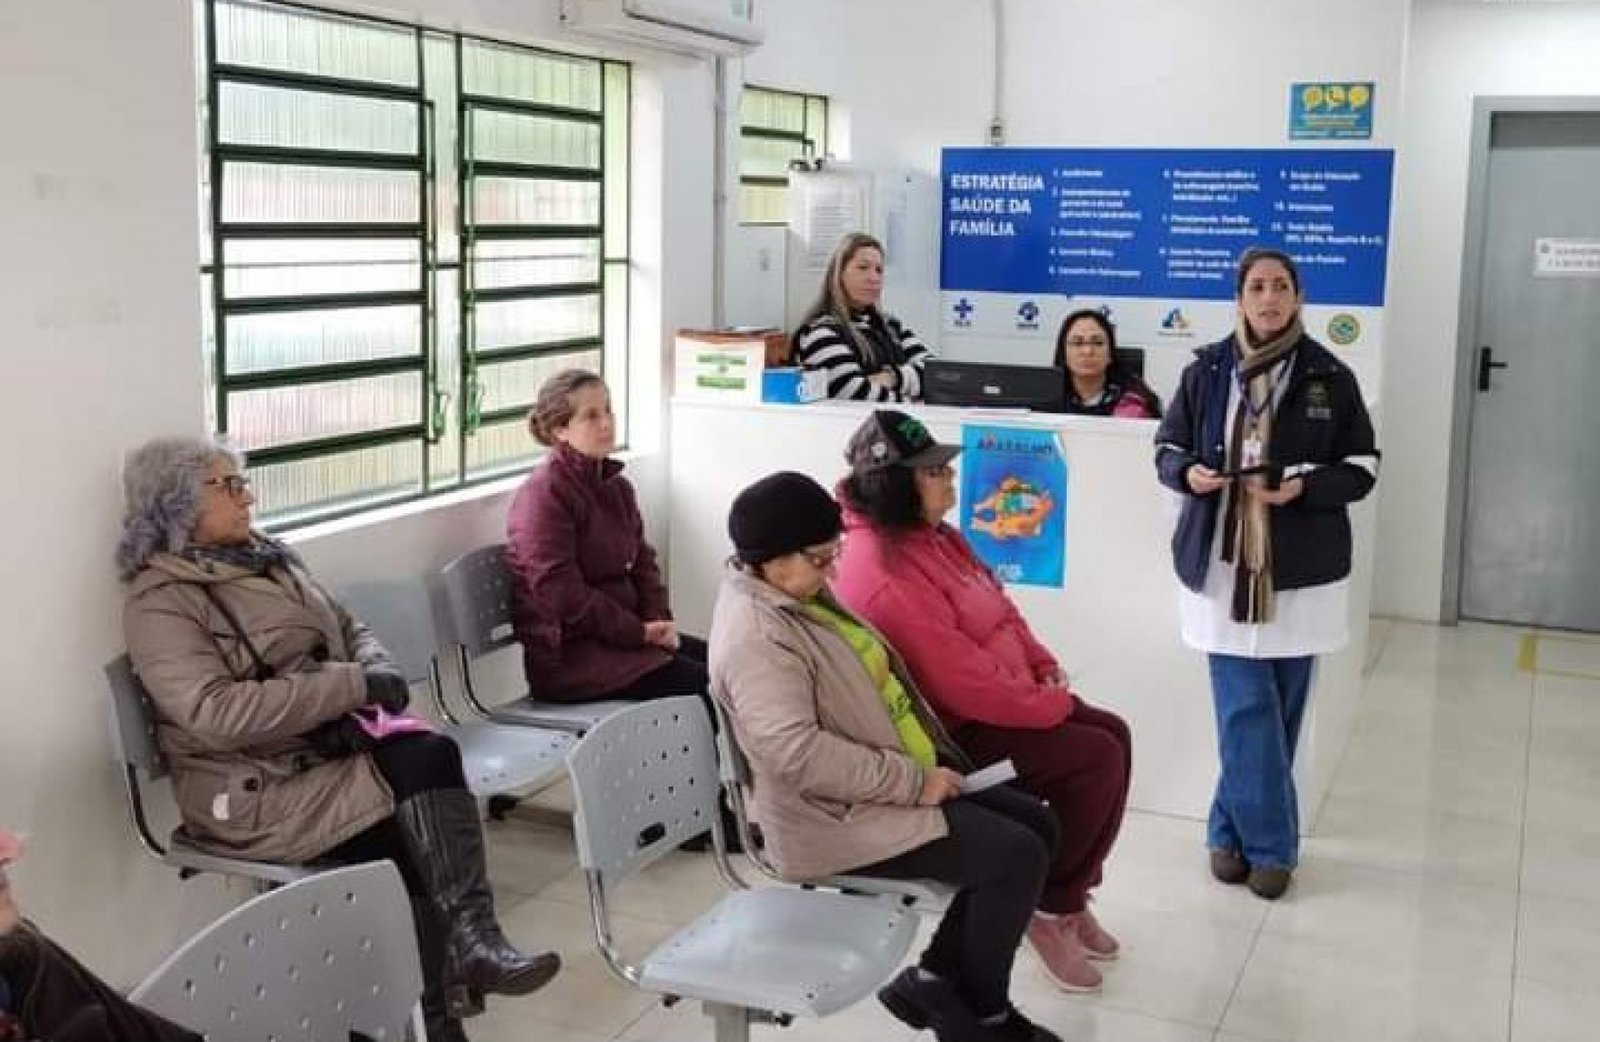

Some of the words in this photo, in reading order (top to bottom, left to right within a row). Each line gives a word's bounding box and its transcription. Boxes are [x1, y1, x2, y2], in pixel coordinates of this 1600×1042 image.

[951, 172, 1043, 190] ESTRATÉGIA
[950, 195, 1005, 214] SAÚDE
[1010, 198, 1031, 214] DA
[950, 218, 1014, 237] FAMÍLIA
